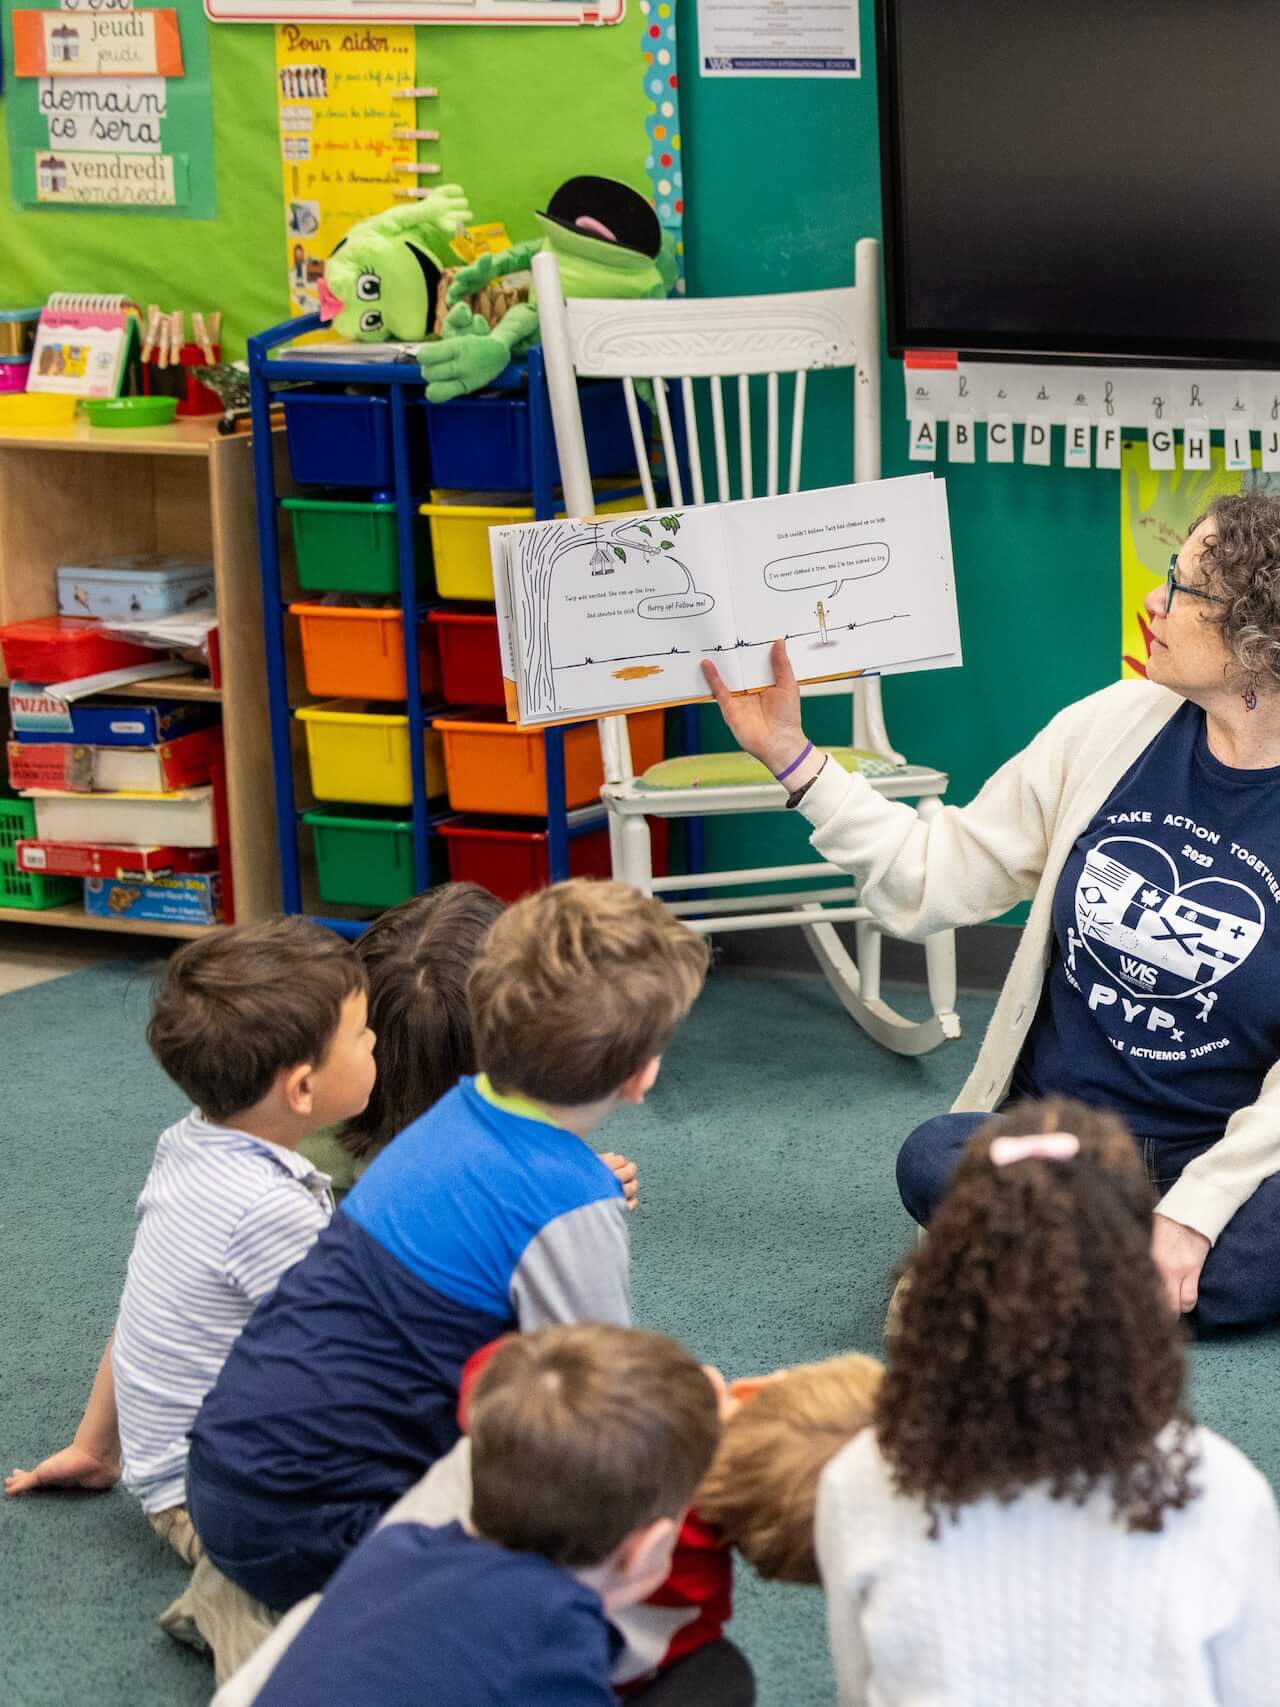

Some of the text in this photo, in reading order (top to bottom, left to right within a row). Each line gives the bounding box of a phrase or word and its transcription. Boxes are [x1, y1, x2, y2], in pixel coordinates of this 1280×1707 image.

[90, 12, 144, 42] jeudi
[282, 23, 331, 51] Pour
[97, 47, 144, 72] jeudi
[41, 77, 167, 114] demain
[51, 117, 162, 144] ce sera
[71, 155, 166, 180] vendredi
[916, 386, 928, 397] a
[958, 376, 970, 398] b
[997, 389, 1007, 400] c
[1036, 385, 1050, 401] d
[1075, 394, 1087, 404] e
[1104, 382, 1115, 417] f
[1152, 396, 1166, 419] g
[1190, 384, 1204, 408] h
[1232, 396, 1246, 409] i
[917, 423, 933, 442] A
[956, 425, 968, 444] B
[990, 424, 1007, 444] C
[1032, 426, 1045, 445] D
[1074, 428, 1085, 448] E
[1105, 430, 1115, 450] F
[1153, 431, 1171, 452] G
[1190, 439, 1203, 459] H
[1234, 439, 1240, 459] I
[1269, 433, 1278, 453] J
[597, 610, 616, 618] shouted
[647, 599, 706, 613] Hurry up! Follow me!
[1107, 811, 1153, 826] TAKE
[1163, 814, 1221, 845] ACTION
[1181, 844, 1214, 869] 2023
[1119, 955, 1159, 986] WIS
[1130, 1037, 1231, 1062] ACTUEMOS JUNTOS
